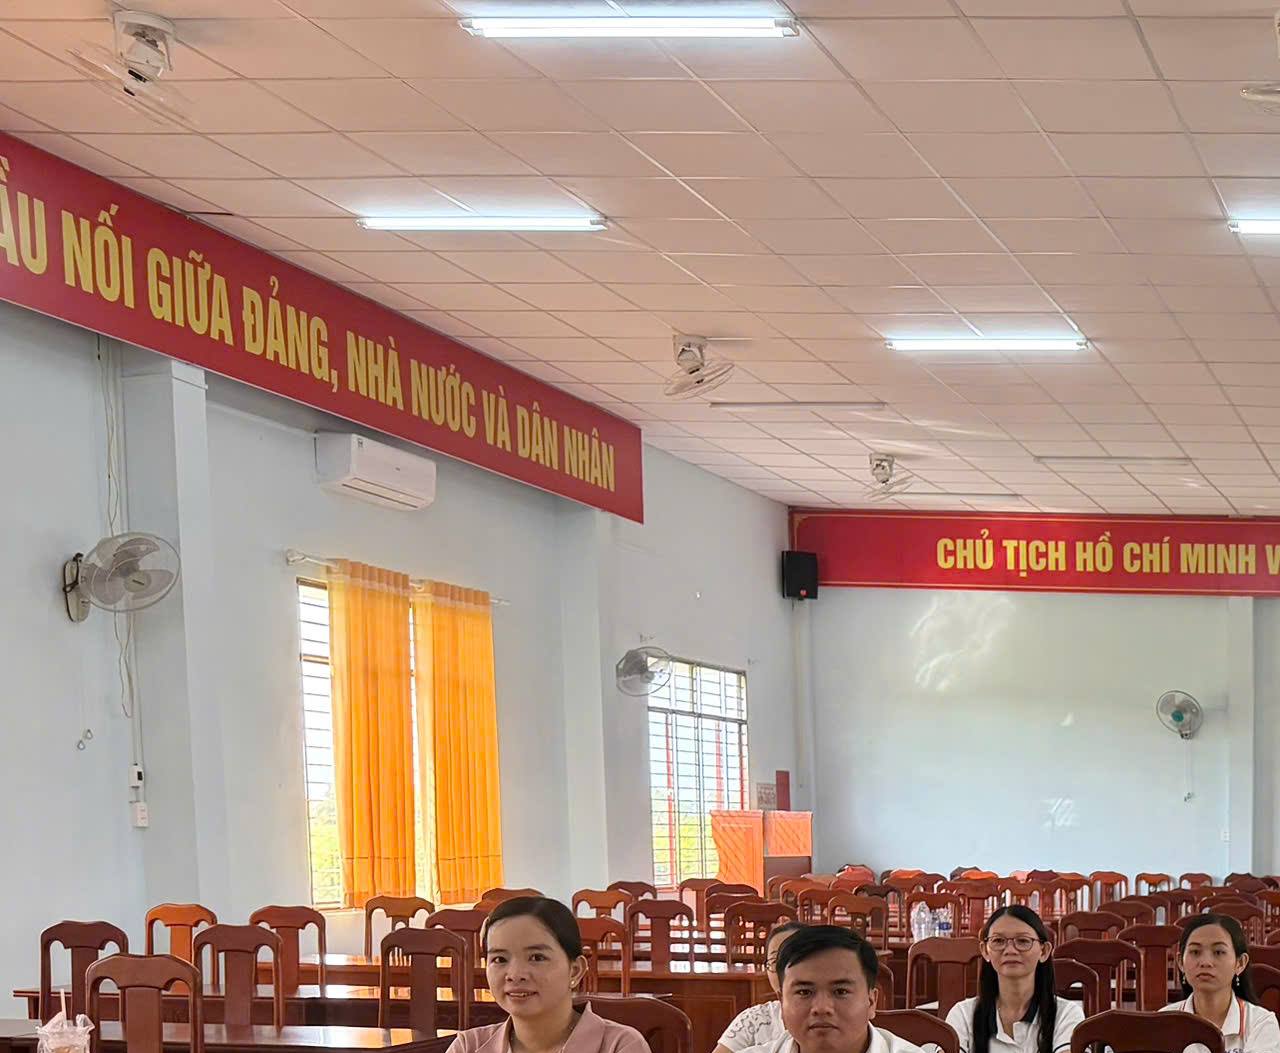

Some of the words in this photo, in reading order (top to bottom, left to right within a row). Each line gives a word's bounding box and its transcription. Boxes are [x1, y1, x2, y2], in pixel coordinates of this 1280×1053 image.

[61, 203, 135, 309] NỐI
[147, 249, 235, 346] GIỮA
[242, 275, 338, 393] ĐẢNG,
[346, 335, 404, 411] NHÀ
[410, 358, 477, 439] NƯỚC
[482, 385, 512, 452] VÀ
[516, 401, 559, 471] DÂN
[563, 427, 616, 492] NHÂN
[936, 528, 994, 570] CHỦ
[1002, 539, 1067, 577] TỊCH
[1075, 531, 1114, 573] HỒ
[1122, 536, 1170, 574] CHÍ
[1180, 543, 1257, 575] MINH
